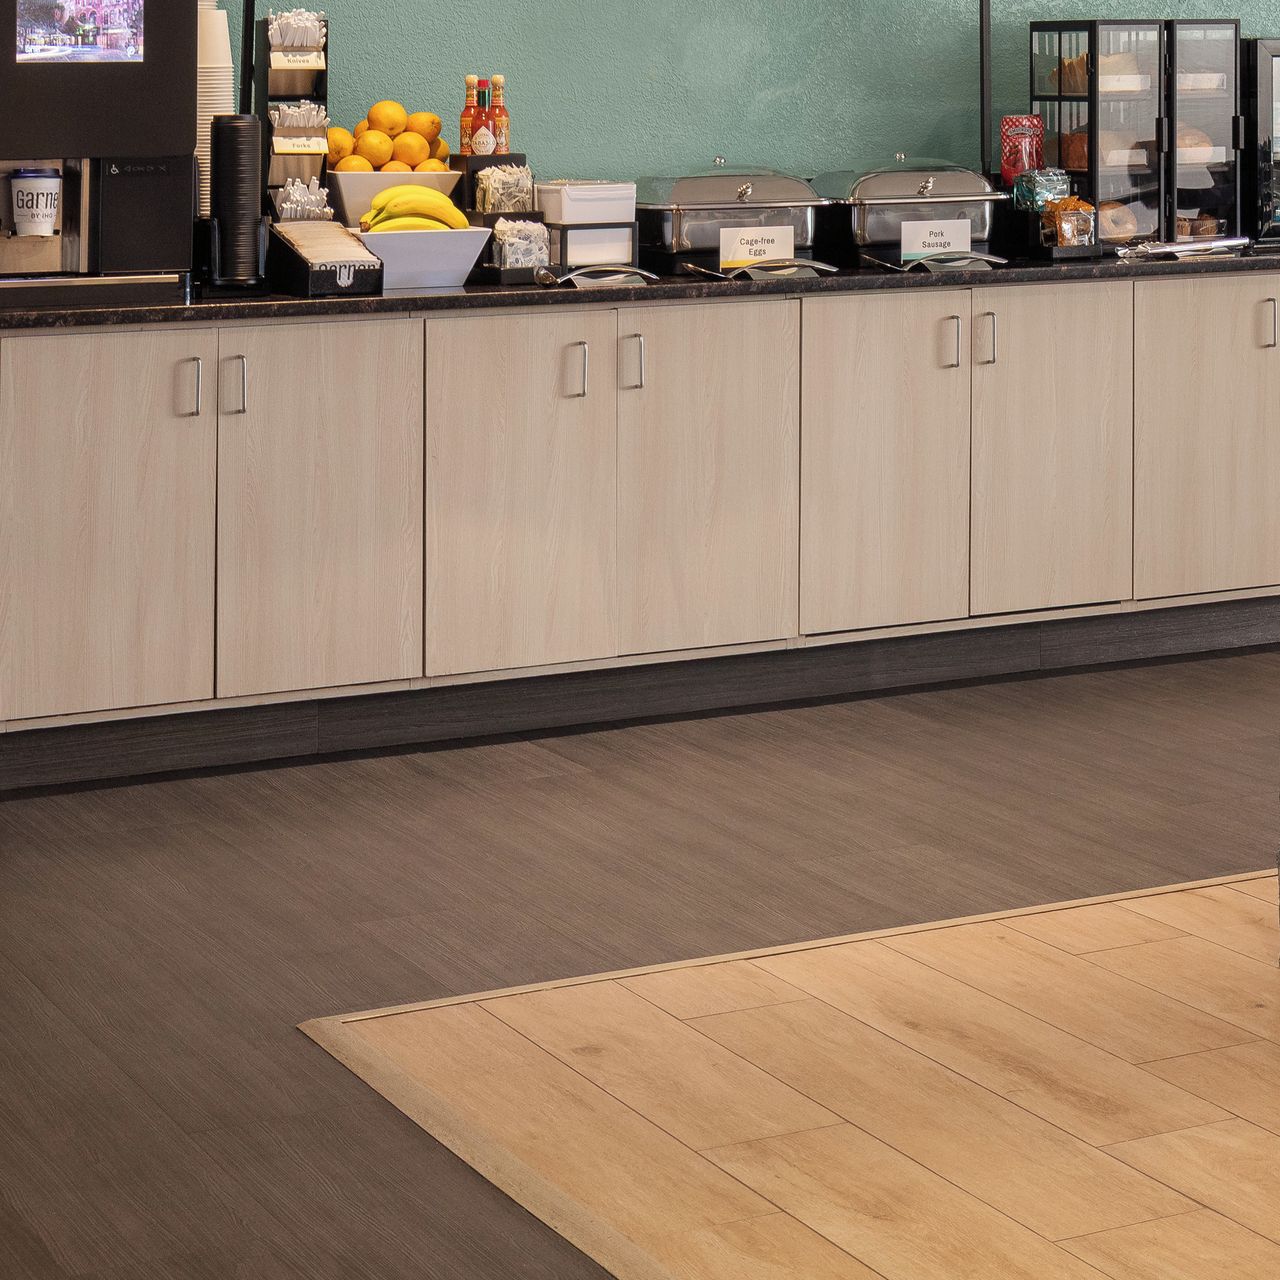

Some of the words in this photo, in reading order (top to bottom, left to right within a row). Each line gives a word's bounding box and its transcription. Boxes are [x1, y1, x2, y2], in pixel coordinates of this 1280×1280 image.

[928, 230, 945, 238] Pork
[739, 236, 776, 246] Cage-free
[921, 240, 952, 249] Sausage
[748, 248, 767, 258] Eggs
